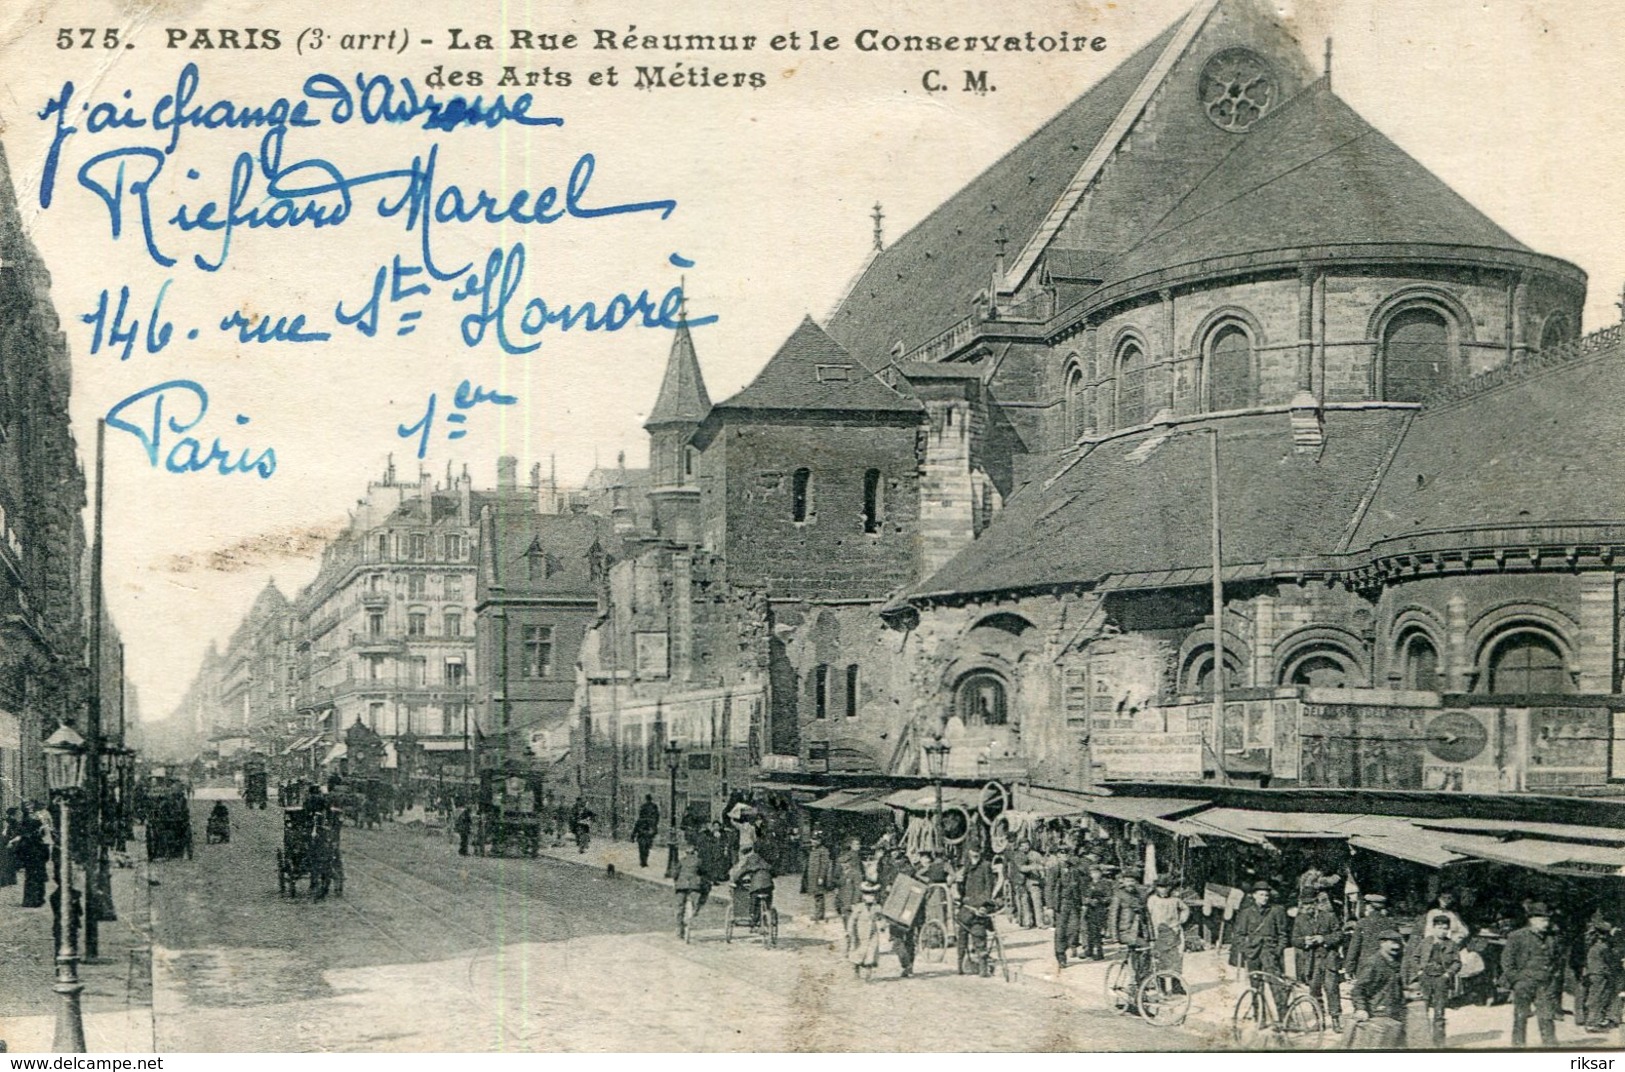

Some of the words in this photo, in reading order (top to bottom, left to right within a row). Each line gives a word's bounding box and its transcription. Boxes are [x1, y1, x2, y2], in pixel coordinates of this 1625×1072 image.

[78, 147, 400, 270] Richard
[378, 143, 676, 281] Marcel
[221, 312, 331, 344] rue
[106, 381, 278, 480] Paris
